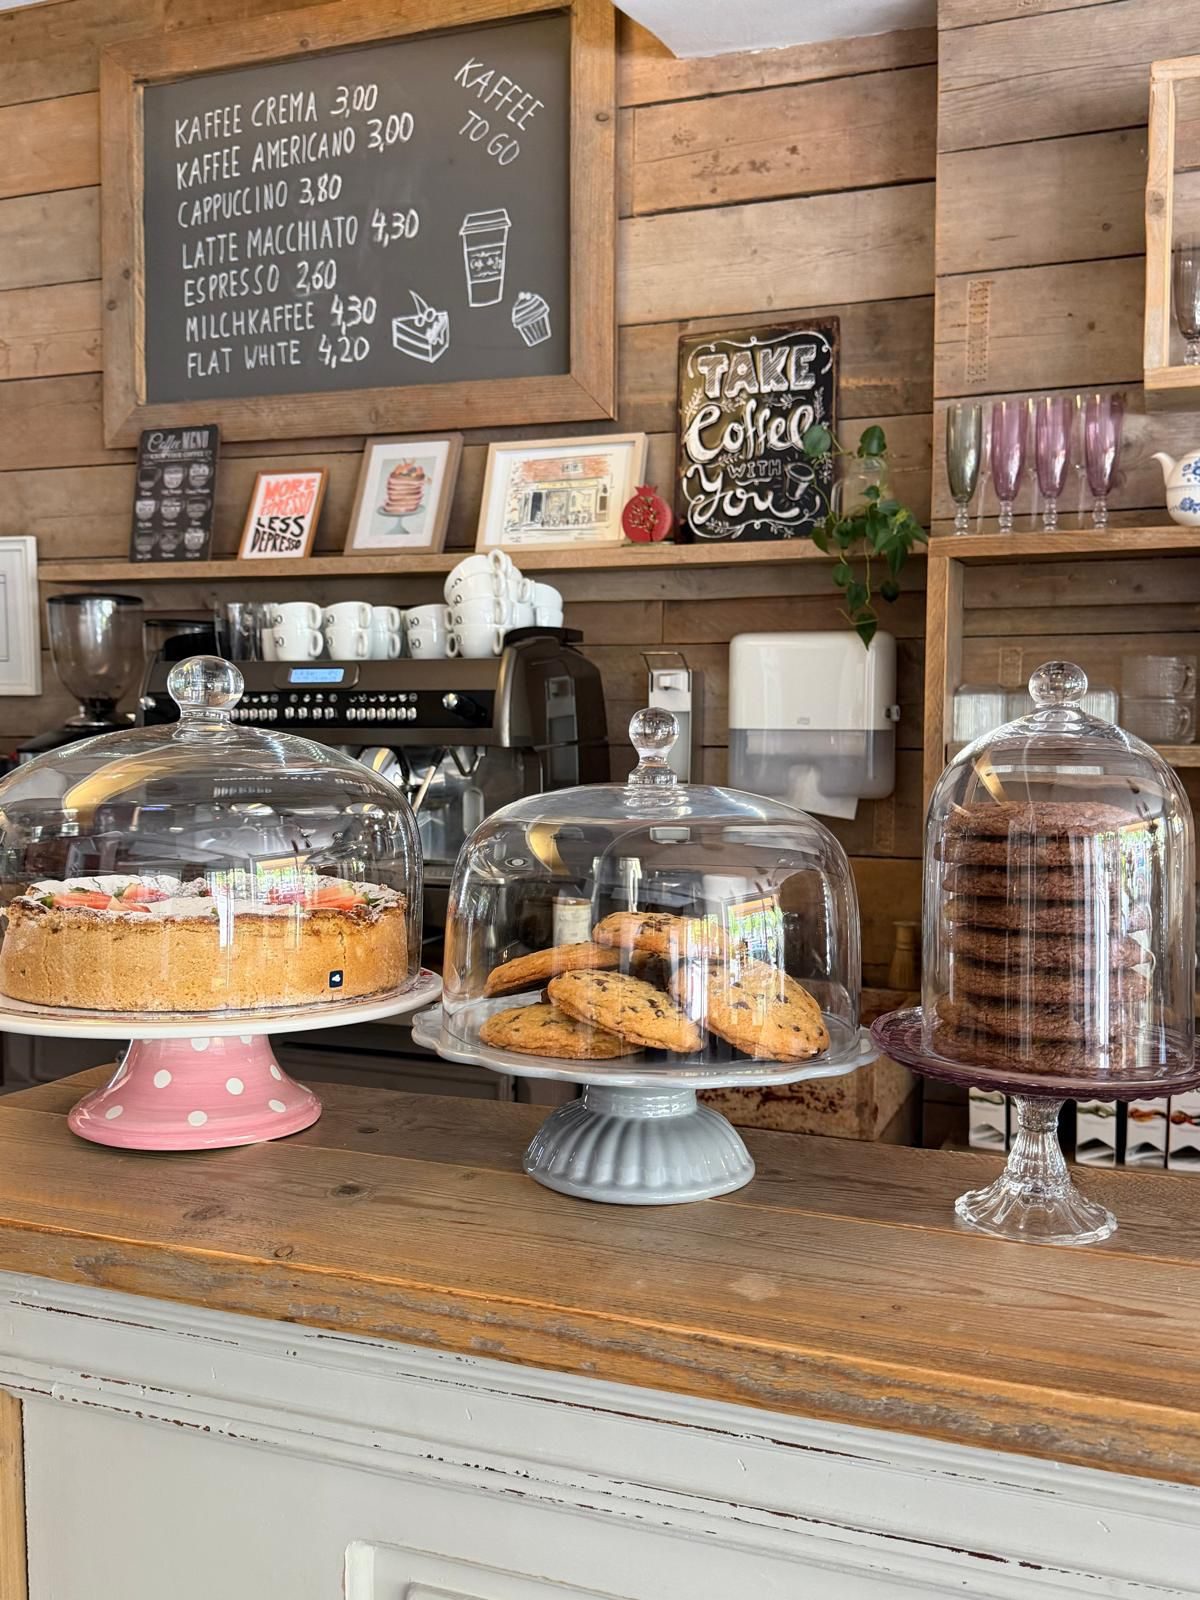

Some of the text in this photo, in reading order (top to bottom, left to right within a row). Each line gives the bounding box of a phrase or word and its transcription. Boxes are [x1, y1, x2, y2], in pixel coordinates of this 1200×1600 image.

[175, 84, 378, 148] KAFFEE CREMA 3,00
[454, 57, 545, 131] KAFFEE
[176, 112, 414, 190] KAFFEE AMERICANO 3,00
[458, 109, 520, 165] TO GO
[178, 173, 342, 228] CAPPUCCINO 3,80
[182, 208, 419, 270] LATTE MACCHIATO 4,30
[184, 259, 337, 307] ESPRESSO 2,60
[186, 295, 377, 342] MILCHKAFFEE 4,30
[187, 335, 370, 378] FLAT WHITE 4,20
[697, 344, 817, 398] TAKE
[182, 431, 209, 449] MENU
[686, 399, 814, 463] Coffee
[265, 478, 317, 500] MORE
[726, 459, 782, 479] WITH
[250, 527, 302, 553] DEPRESSO
[256, 515, 305, 538] LESS
